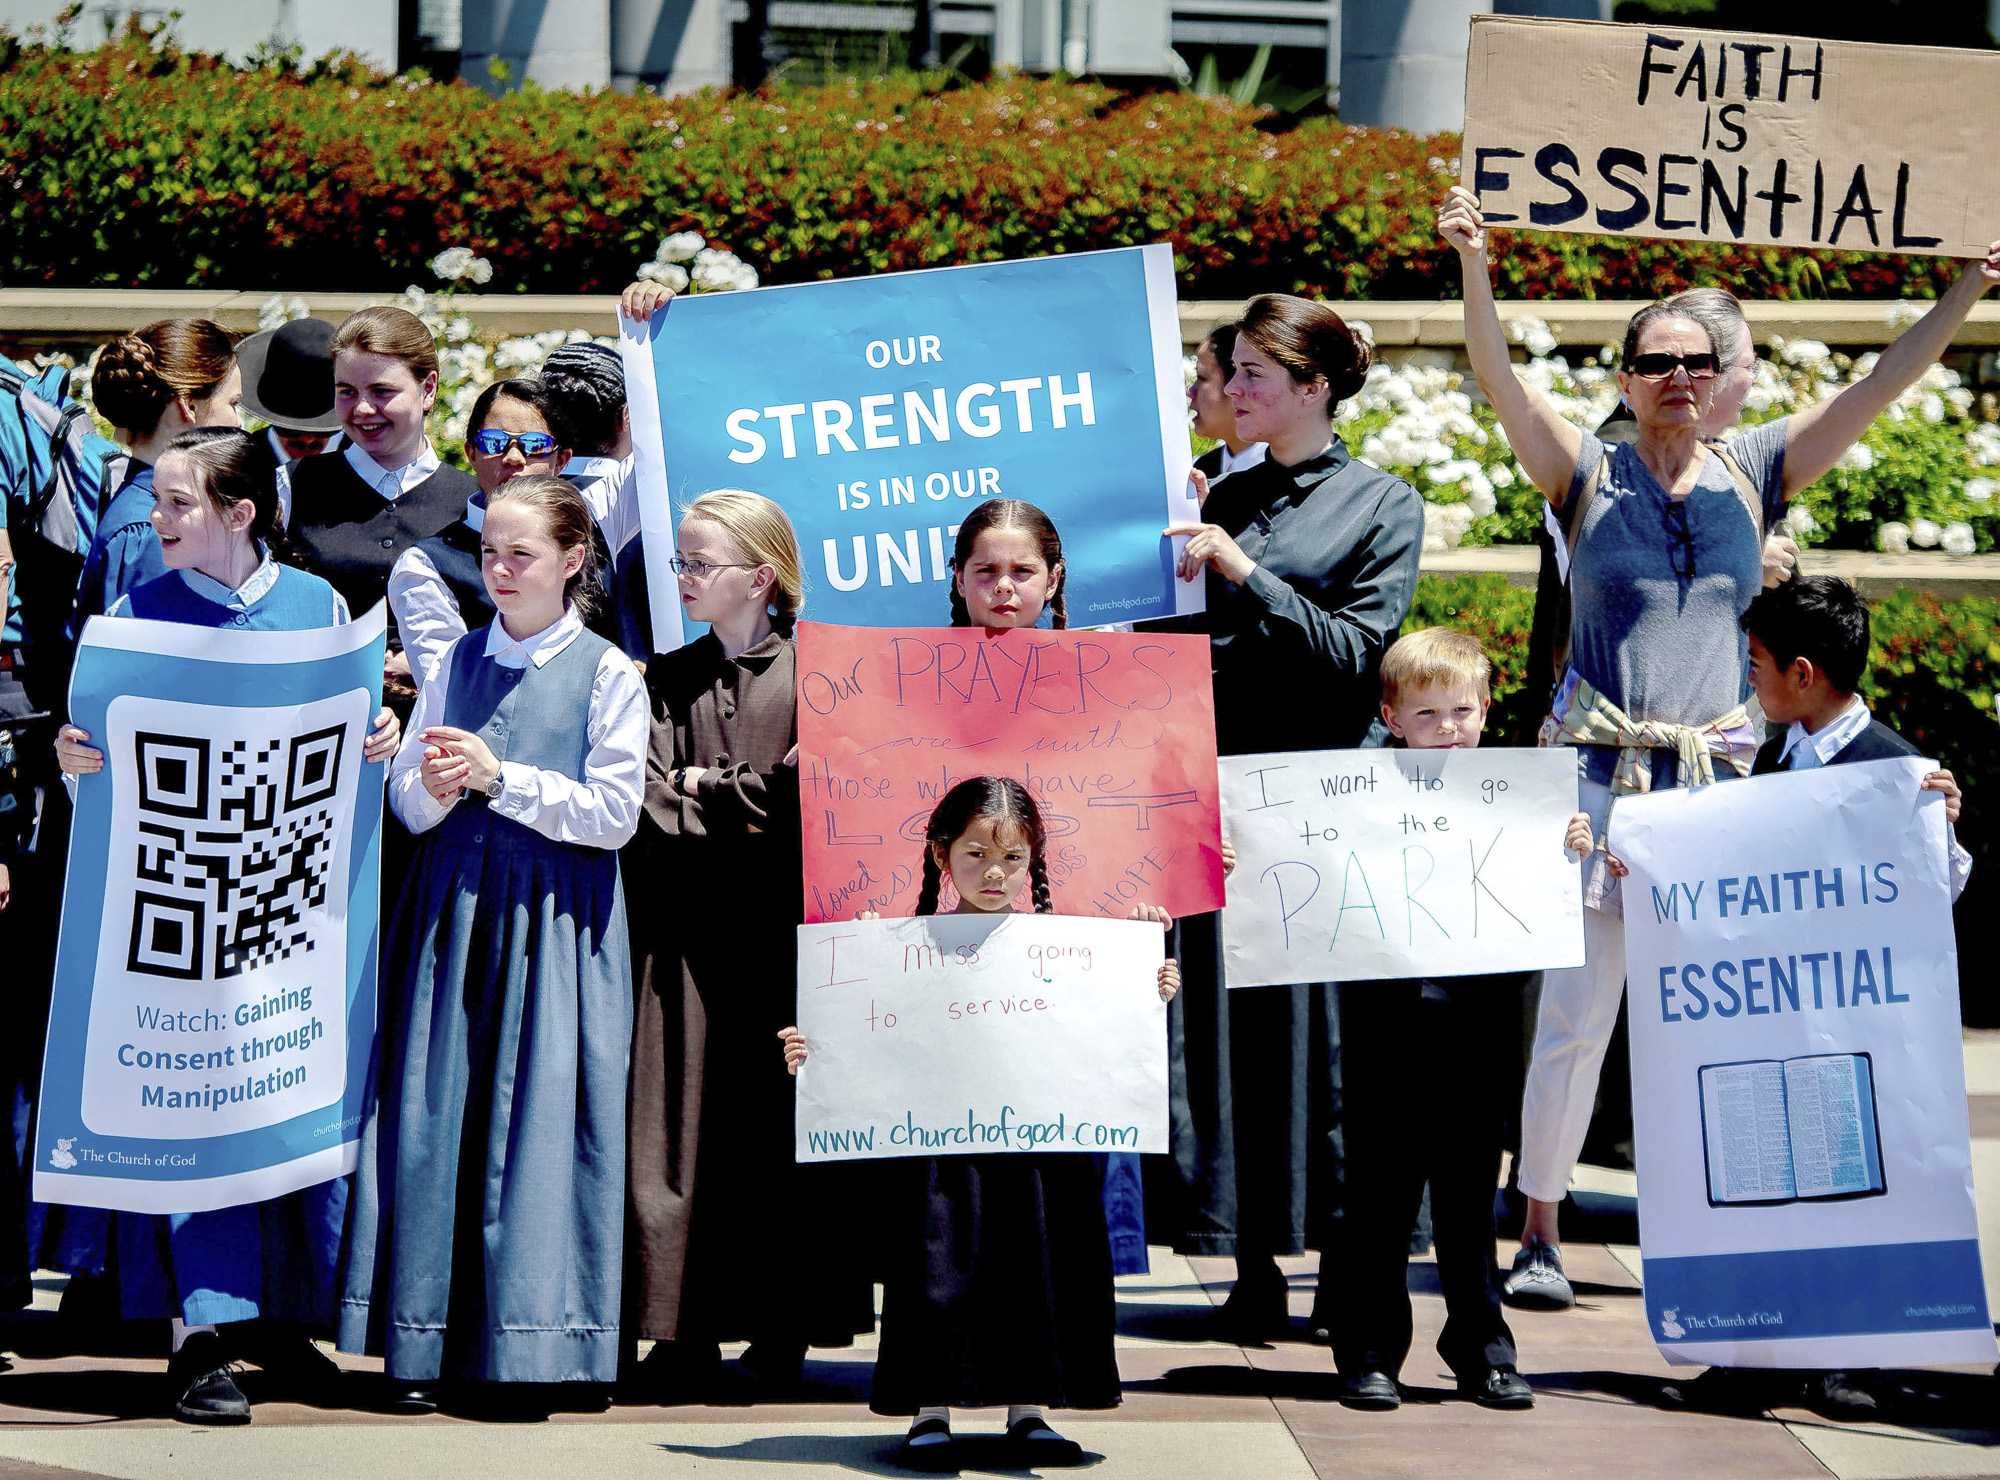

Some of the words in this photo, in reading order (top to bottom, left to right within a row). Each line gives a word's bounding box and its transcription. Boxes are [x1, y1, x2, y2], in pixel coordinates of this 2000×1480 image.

[1638, 33, 1824, 105] FAITH
[1702, 103, 1748, 153] IS
[865, 334, 944, 369] OUR
[725, 371, 1097, 464] STRENGTH
[837, 479, 871, 511] IS
[879, 474, 916, 507] IN
[924, 467, 1003, 501] OUR
[822, 525, 961, 591] UNI
[1088, 595, 1161, 612] churchofgod.com
[802, 656, 864, 715] Our
[889, 637, 1176, 714] PRAYERS
[856, 735, 998, 756] are
[1020, 720, 1163, 753] with
[801, 761, 896, 800] those
[918, 764, 963, 800] wh
[1025, 762, 1136, 794] have
[1245, 765, 1294, 812] I
[1320, 766, 1378, 797] want
[1410, 765, 1444, 793] to
[1481, 779, 1509, 804] go
[1299, 821, 1339, 846] to
[1398, 813, 1450, 835] the
[1092, 845, 1176, 916] HOPE
[1260, 827, 1532, 952] PARK
[1651, 879, 1705, 924] MY
[1717, 867, 1845, 918] FAITH
[1859, 862, 1899, 905] IS
[816, 934, 869, 989] I
[904, 938, 980, 973] miss
[1027, 944, 1092, 978] going
[1659, 947, 1910, 1023] ESSENTIAL
[136, 1005, 227, 1033] Watch:
[234, 985, 313, 1027] Gaining
[865, 999, 897, 1032] to
[117, 1043, 235, 1071] Consent
[241, 1017, 323, 1063] through
[141, 1064, 307, 1112] Manipulation
[81, 1148, 104, 1163] The
[107, 1151, 151, 1166] Church
[155, 1153, 168, 1167] of
[170, 1152, 196, 1167] God
[1685, 1316, 1706, 1329] The
[1708, 1313, 1746, 1328] Church
[1748, 1313, 1759, 1326] of
[1760, 1311, 1784, 1326] God
[1904, 1303, 1977, 1318] churchofgod.com
